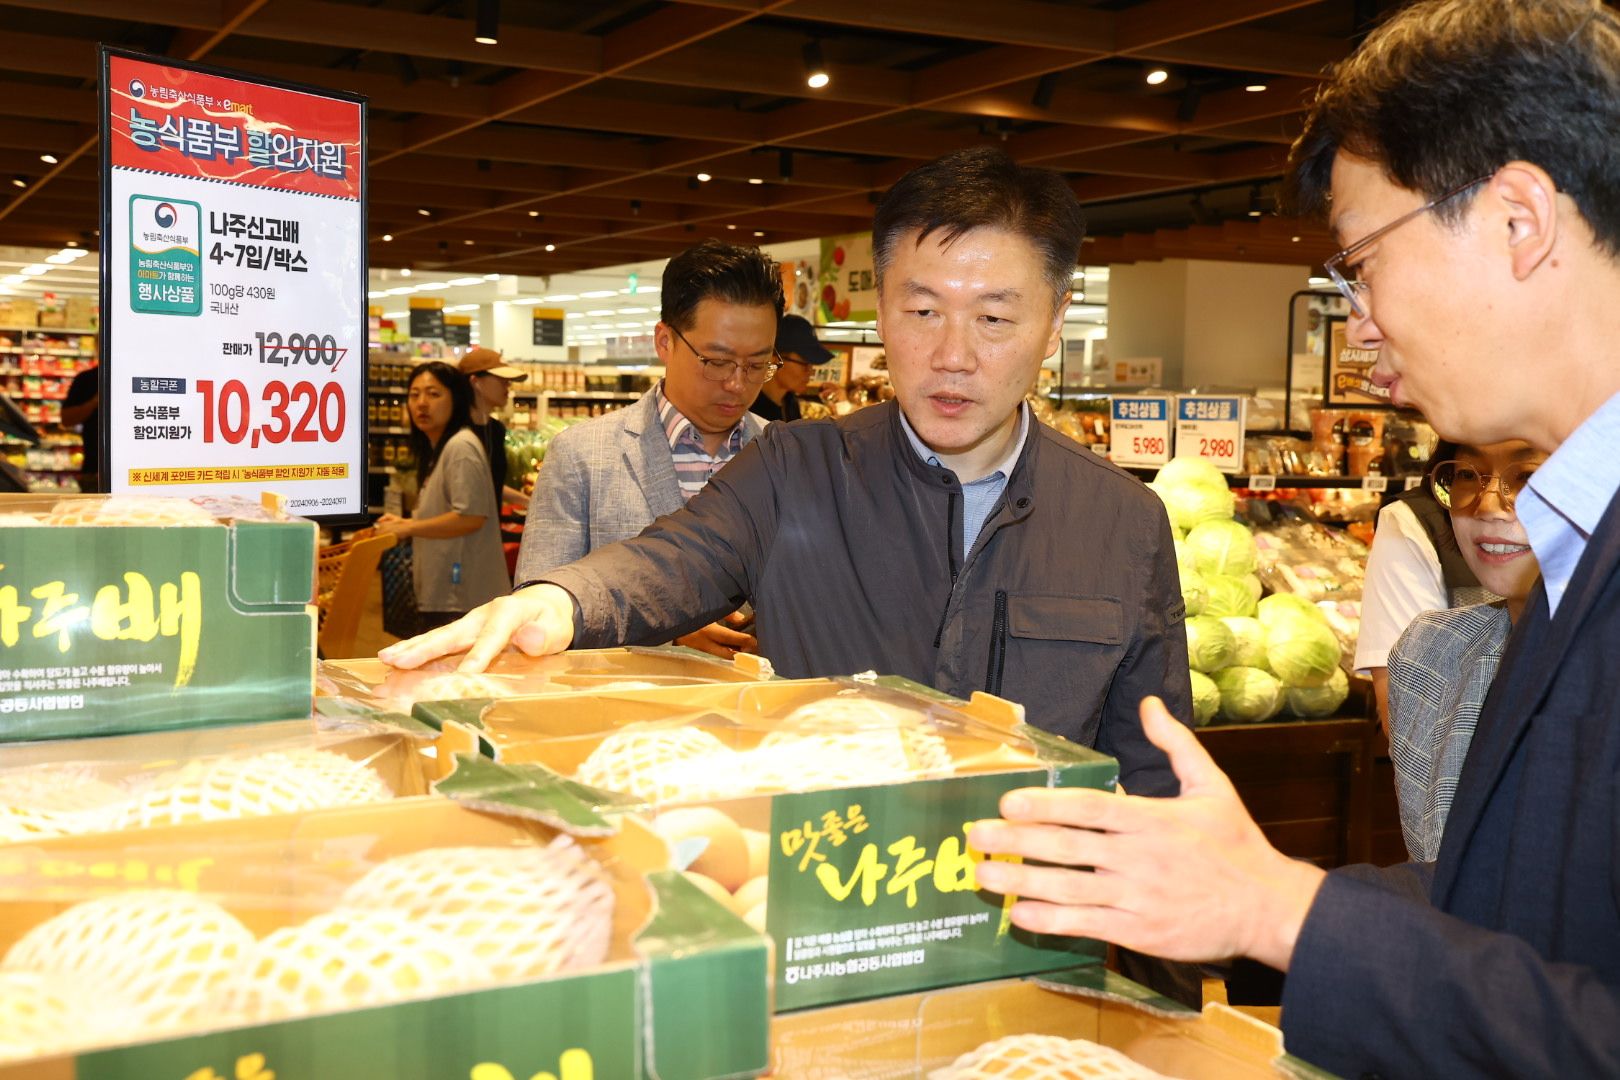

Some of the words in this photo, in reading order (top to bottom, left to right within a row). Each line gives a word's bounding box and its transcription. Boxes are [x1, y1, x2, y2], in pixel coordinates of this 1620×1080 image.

[150, 85, 213, 107] 농림축산식품부
[223, 99, 254, 115] emart
[129, 107, 240, 160] 농식품부
[247, 128, 342, 175] 할인지원
[209, 211, 299, 244] 나주신고배
[143, 232, 189, 245] 농림축산식품부
[138, 259, 193, 272] 농림축산식품부와
[209, 242, 308, 273] 4~7입/박스
[137, 269, 166, 280] 이마트가
[167, 272, 194, 283] 함께하는
[138, 282, 195, 304] 행사상품
[209, 283, 244, 300] 100g당
[246, 286, 276, 300] 430원
[209, 302, 239, 316] 국내산
[222, 342, 253, 356] 판매가
[255, 331, 337, 367] 12,900
[140, 379, 178, 392] 농할쿠폰
[133, 405, 181, 421] 농식품부
[196, 379, 346, 449] 10,320
[1118, 401, 1161, 419] 추천상품
[1184, 401, 1231, 419] 추천상품
[133, 425, 192, 440] 할인지원가
[143, 471, 169, 482] 신세계
[171, 470, 196, 481] 포인트
[197, 469, 214, 481] 카드
[215, 469, 231, 481] 적립
[232, 469, 240, 480] 시
[275, 468, 290, 478] 할인
[317, 466, 330, 476] 자동
[331, 466, 345, 476] 적용
[780, 803, 870, 872] 맛좋은
